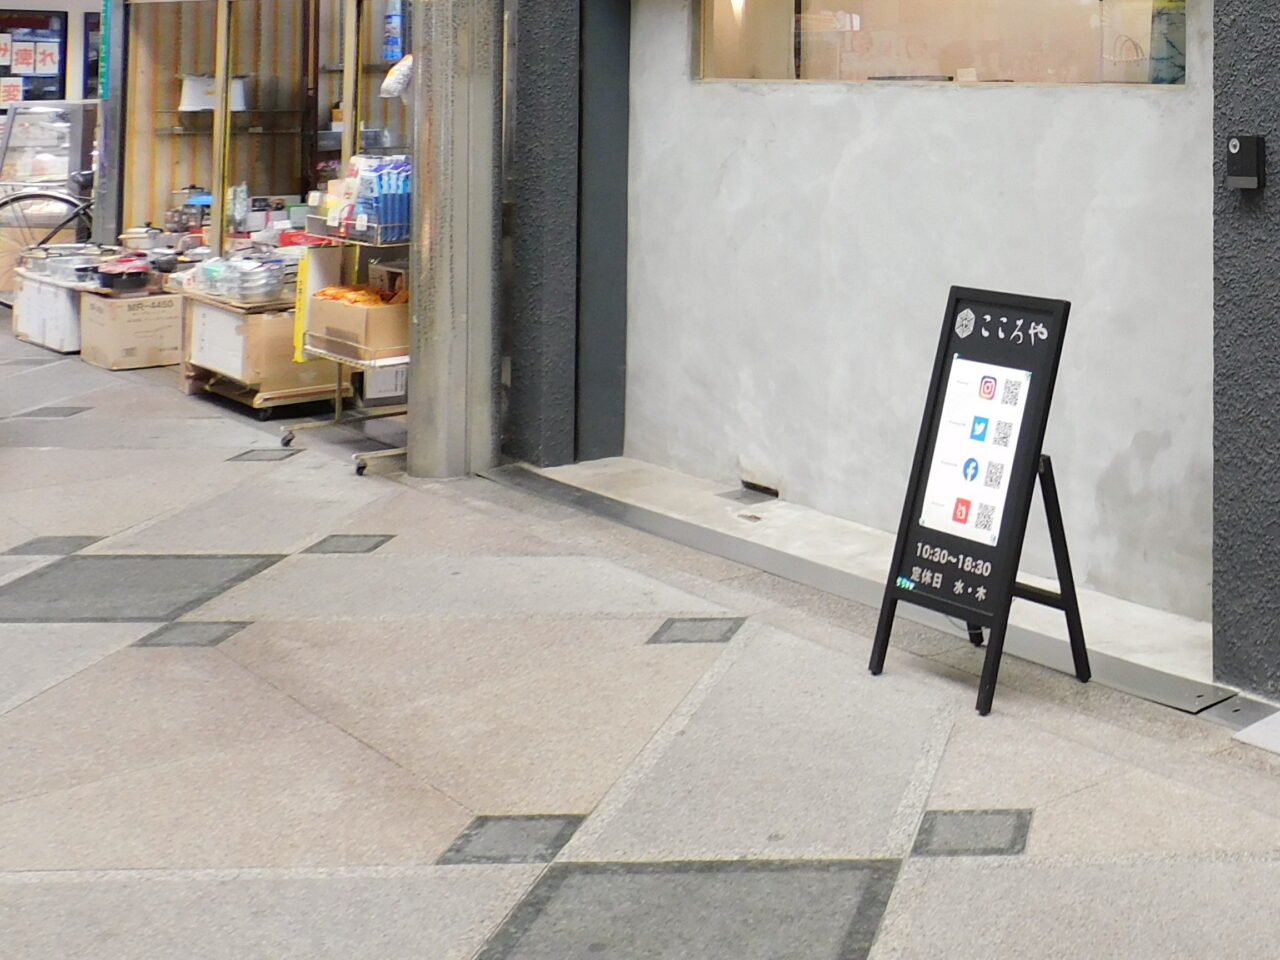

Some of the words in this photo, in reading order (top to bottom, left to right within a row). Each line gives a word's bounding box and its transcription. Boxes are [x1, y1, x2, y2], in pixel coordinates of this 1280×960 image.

[981, 314, 1048, 346] こころや
[910, 566, 943, 589] 定休日
[953, 579, 987, 602] 水・木
